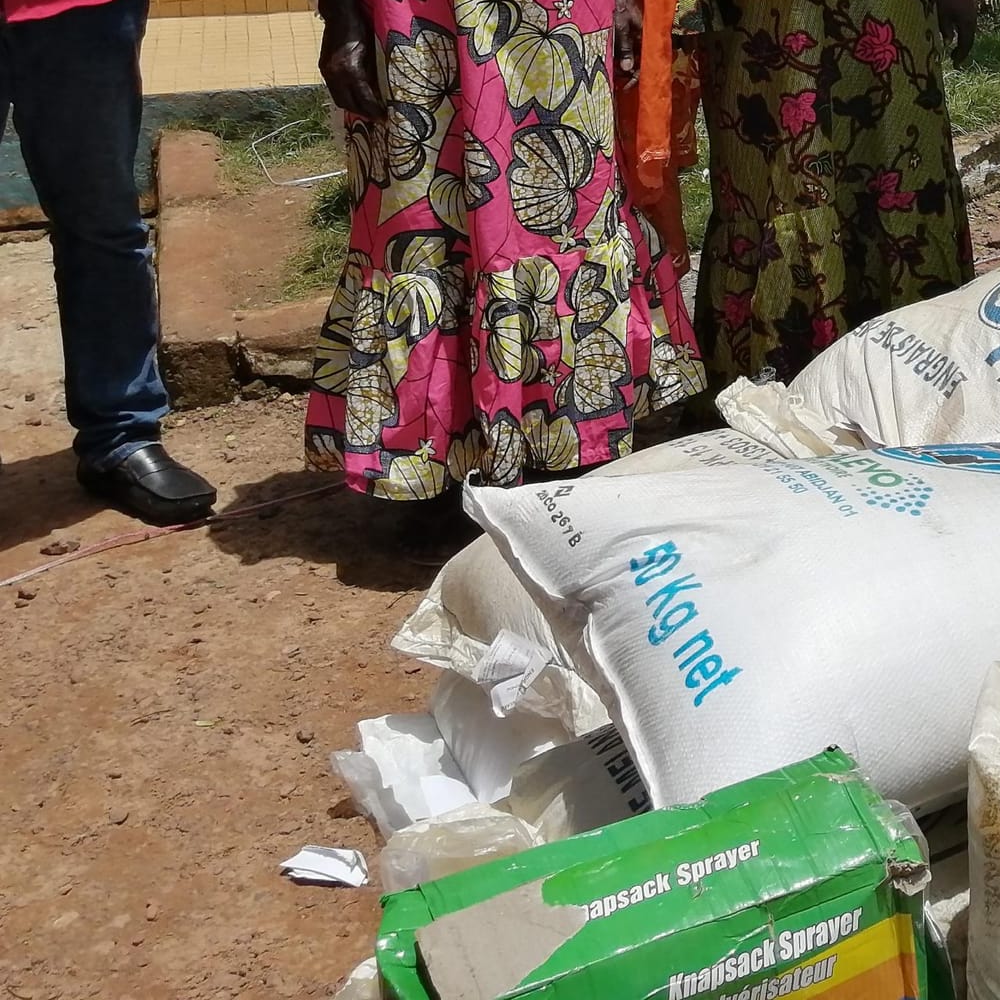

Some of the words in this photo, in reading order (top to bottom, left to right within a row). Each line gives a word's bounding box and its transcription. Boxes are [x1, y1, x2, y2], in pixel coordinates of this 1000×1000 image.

[890, 334, 968, 400] ENGRAIS
[788, 481, 809, 494] 50
[799, 468, 847, 505] ABIDJAN
[838, 504, 859, 518] 01
[828, 453, 904, 487] LEVO
[629, 539, 683, 586] 50
[645, 572, 703, 646] Kg
[672, 628, 744, 708] net
[584, 872, 671, 921] napsack
[676, 838, 760, 886] Sprayer
[668, 939, 776, 1000] Knapsack
[778, 906, 863, 961] Sprayer
